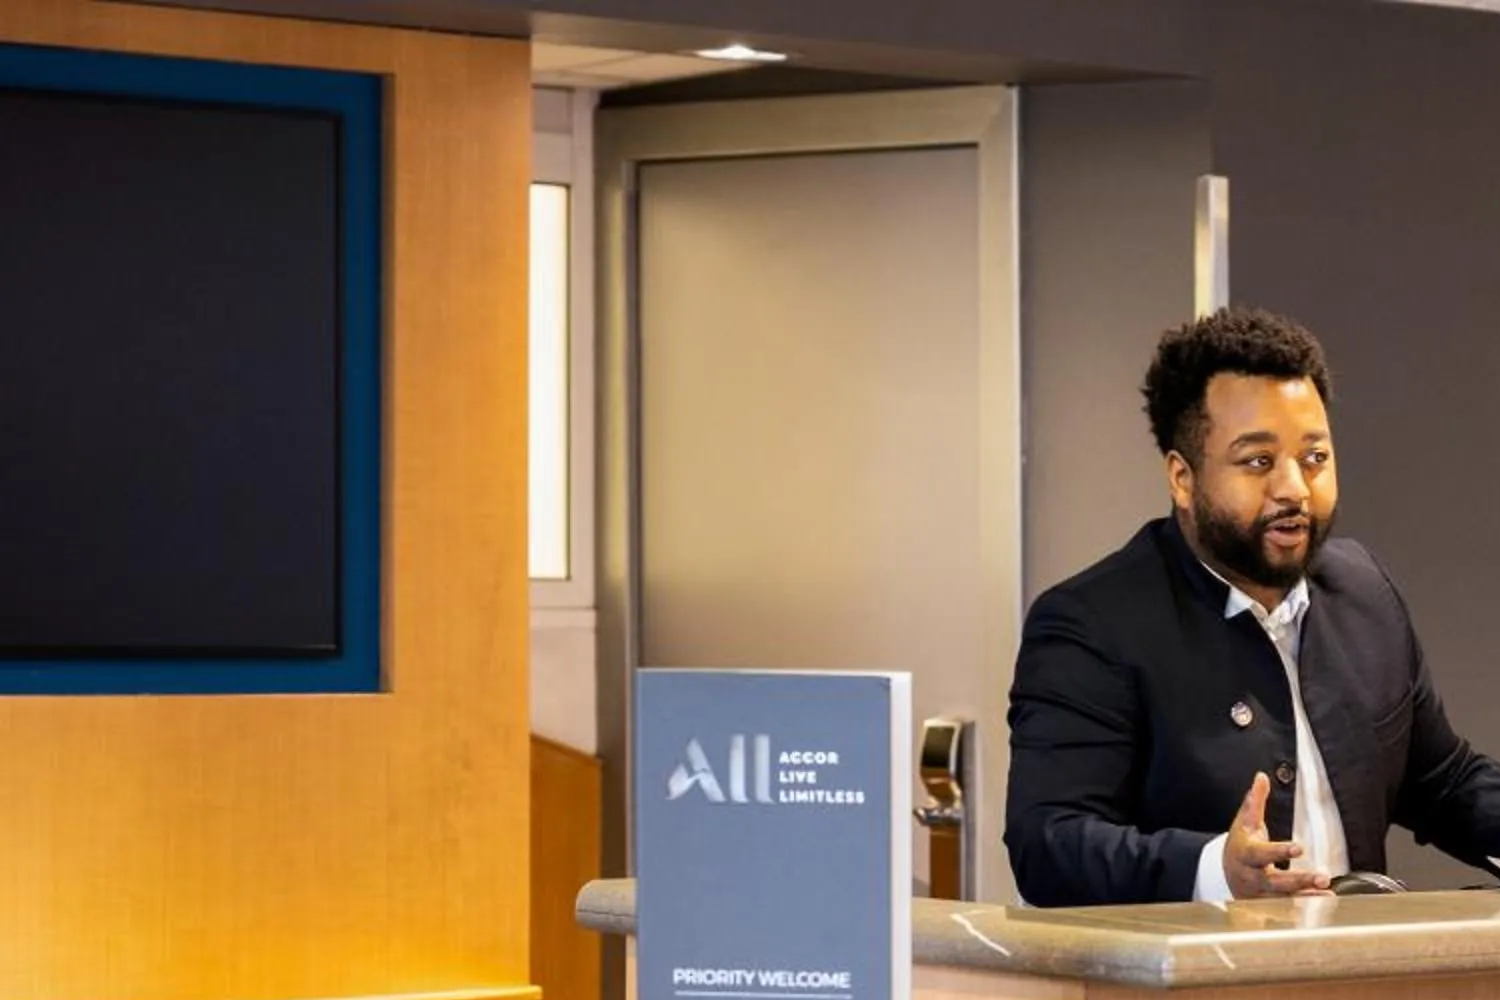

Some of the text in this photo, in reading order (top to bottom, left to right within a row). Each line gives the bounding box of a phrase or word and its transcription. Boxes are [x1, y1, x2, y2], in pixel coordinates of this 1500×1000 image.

[778, 751, 840, 765] ACCOR
[778, 771, 818, 784] LIVE
[778, 790, 866, 805] LIMITLESS
[673, 968, 852, 989] PRIORITY WELCOME
